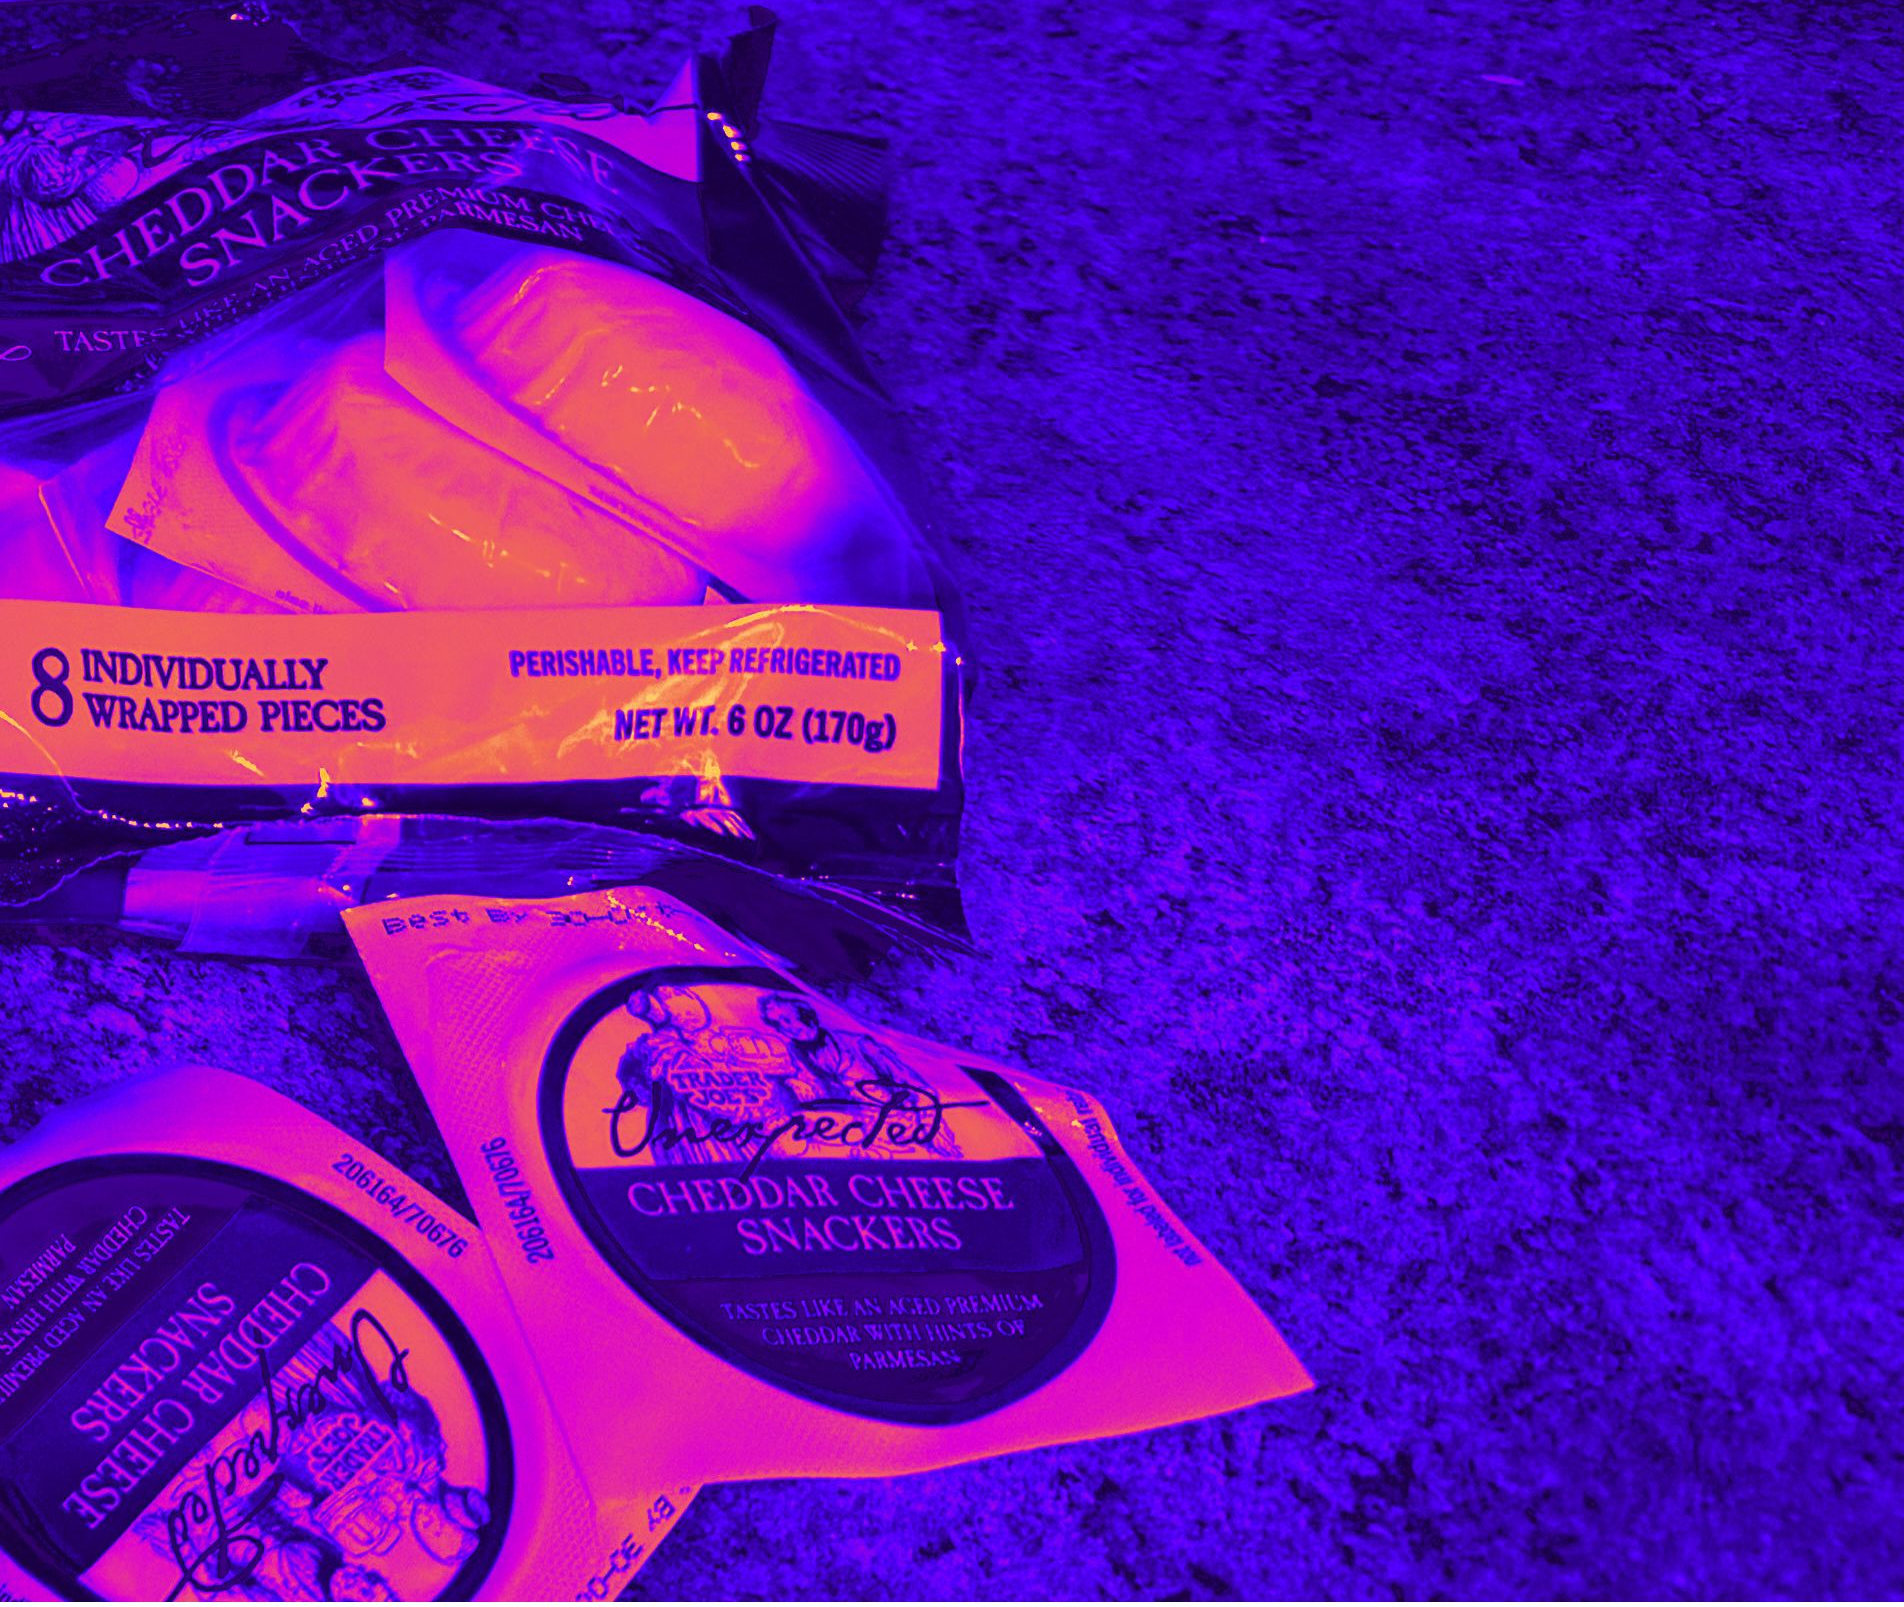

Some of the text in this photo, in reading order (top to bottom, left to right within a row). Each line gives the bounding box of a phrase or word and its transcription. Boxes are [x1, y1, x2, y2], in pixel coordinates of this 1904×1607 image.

[40, 137, 343, 288] CHEDDAR
[180, 149, 523, 288] SNACKERS
[384, 185, 532, 229] PREMIUM
[30, 646, 329, 729] 8 INDIVIDUALLY
[508, 648, 902, 684] PERISHABLE, KEEP REFRIGERATED
[87, 694, 387, 734] WRAPPED PIECES
[613, 705, 897, 752] NET 6 OZ (170g)
[626, 1173, 1015, 1217] CHEDDAR CHEESE
[735, 1215, 963, 1257] SNACKERS
[69, 1281, 236, 1443] SNACKERS
[60, 1397, 195, 1531] CHEESE
